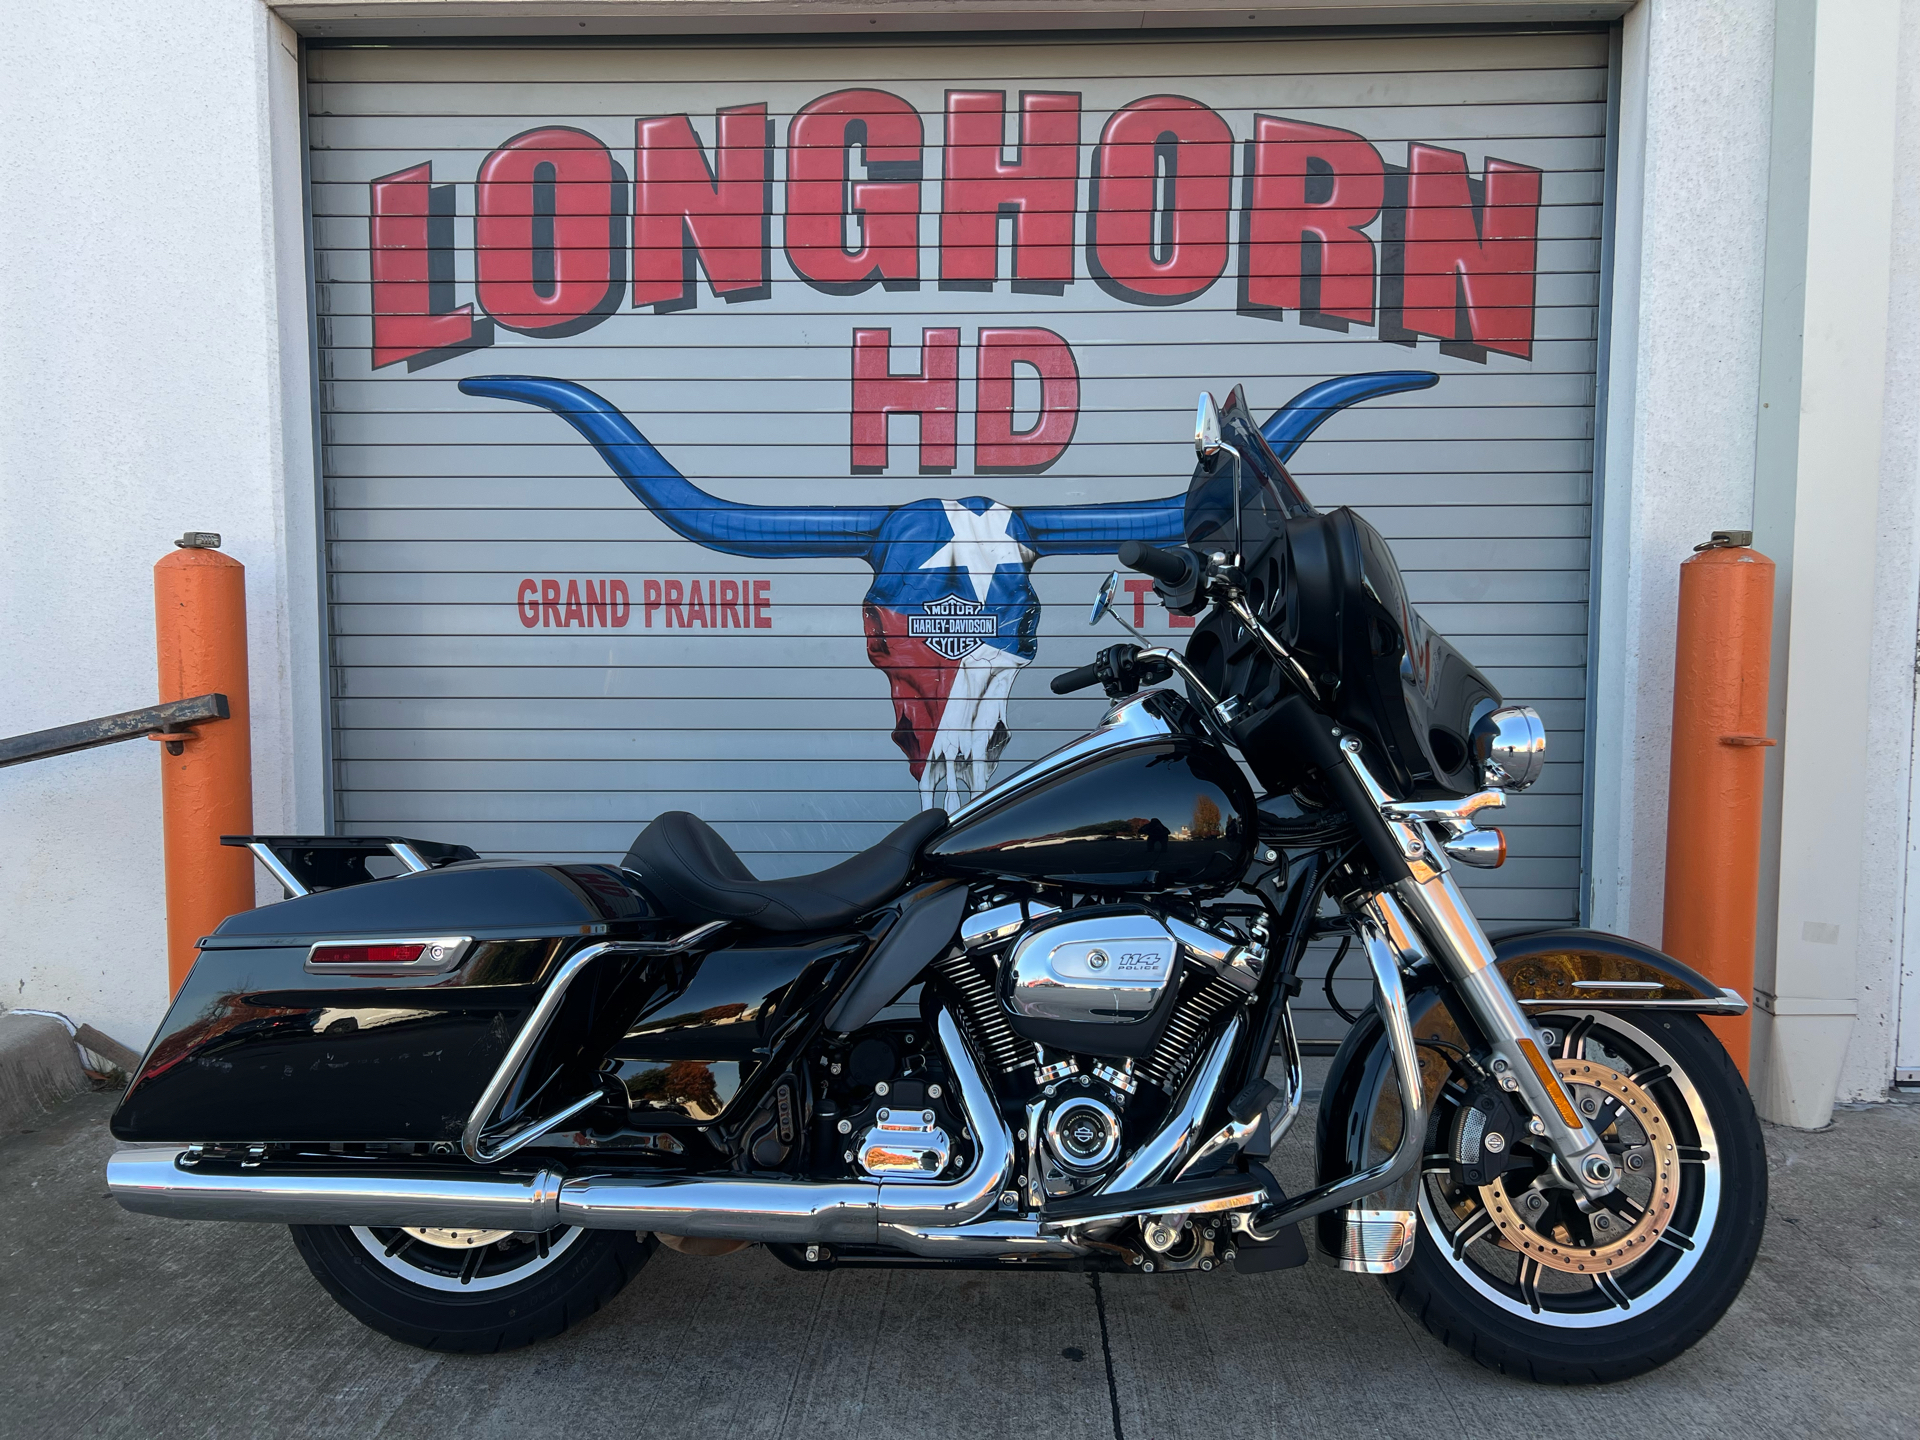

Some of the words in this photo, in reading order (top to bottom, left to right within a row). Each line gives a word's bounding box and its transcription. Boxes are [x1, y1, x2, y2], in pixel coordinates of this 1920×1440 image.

[370, 87, 1543, 373] LONGHORN
[850, 327, 1080, 475] HD
[517, 578, 630, 629] GRAND
[643, 579, 772, 629] PRAIRIE
[931, 600, 974, 615] MOTOR
[912, 618, 993, 634] HARLEY-DAVIDSON
[931, 637, 975, 656] CYCLES
[1119, 952, 1162, 966] 114
